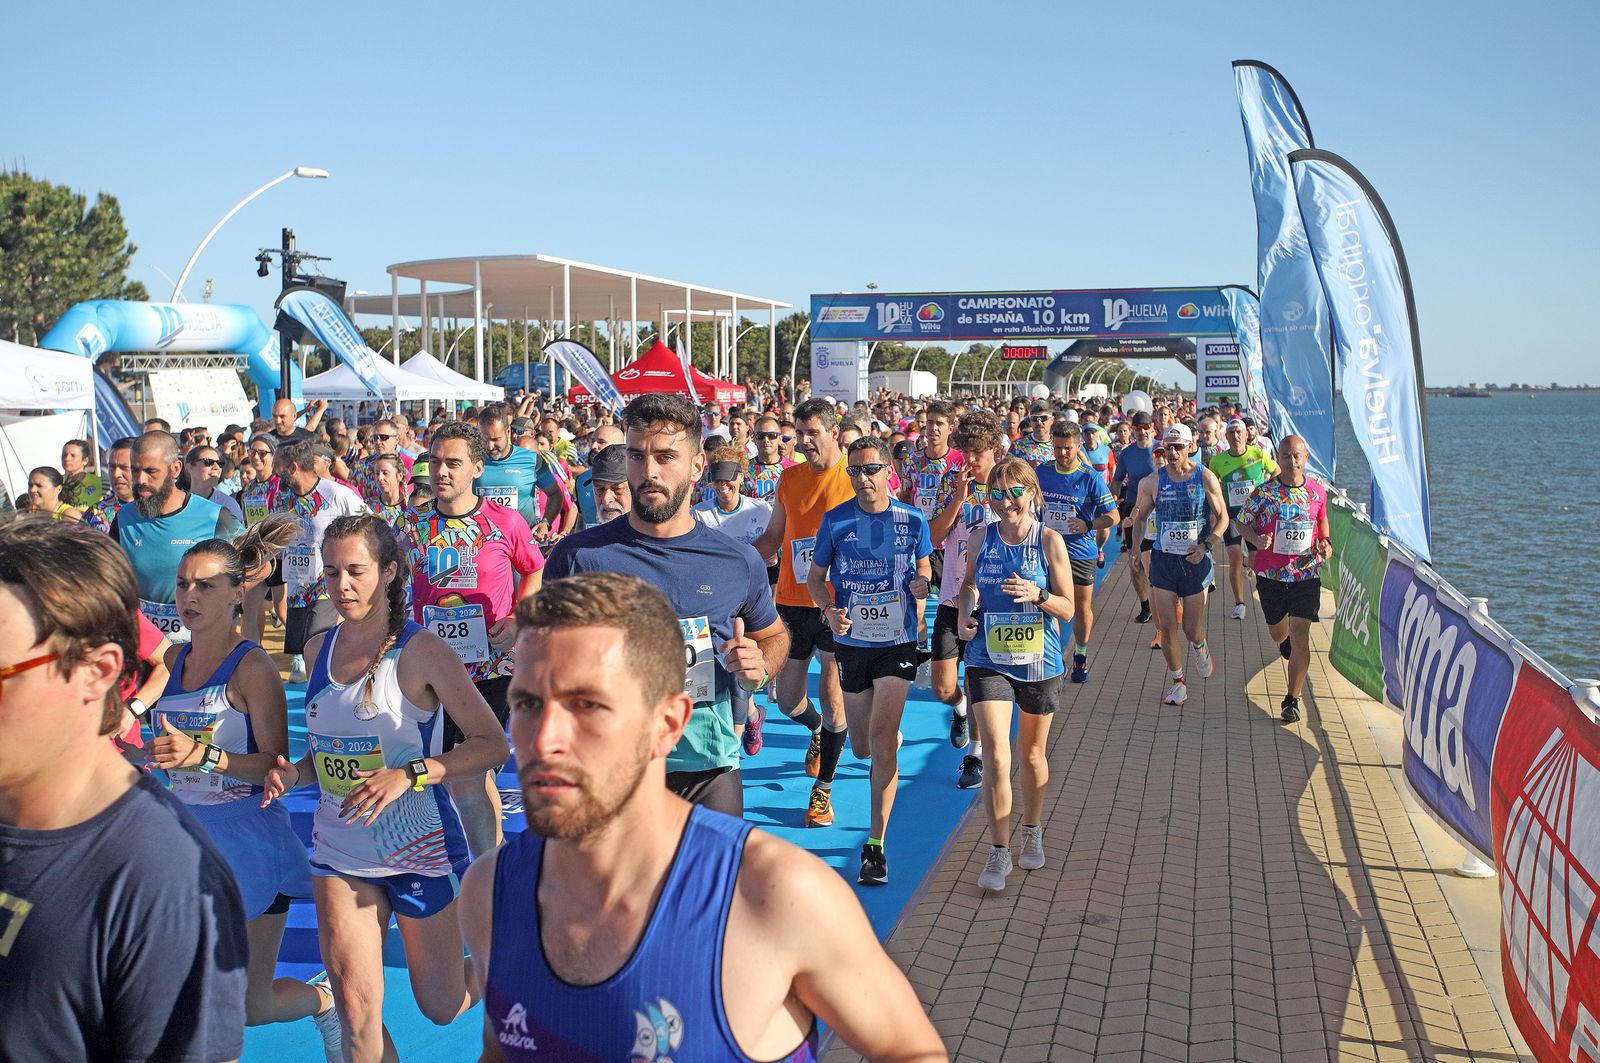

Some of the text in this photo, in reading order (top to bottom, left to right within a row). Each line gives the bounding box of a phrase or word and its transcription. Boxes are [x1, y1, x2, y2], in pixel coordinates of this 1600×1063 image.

[958, 297, 1055, 309] CAMPEONATO
[1127, 304, 1168, 317] HUELVA
[1203, 305, 1232, 317] WiH
[957, 308, 1090, 325] de ESPAÑA 10 km
[920, 322, 941, 330] WiHu
[1004, 325, 1020, 333] ruta
[1022, 325, 1055, 333] Absoluto
[1056, 326, 1062, 334] y
[488, 496, 511, 507] 592
[1050, 511, 1067, 521] 795
[1169, 531, 1189, 540] 938
[1286, 531, 1305, 540] 620
[288, 556, 310, 567] 1839
[860, 606, 889, 620] 994
[146, 615, 181, 633] 626
[437, 622, 469, 638] 828
[995, 627, 1034, 641] 1260
[189, 716, 208, 727] 2023
[348, 741, 373, 752] 2023
[324, 756, 360, 780] 688
